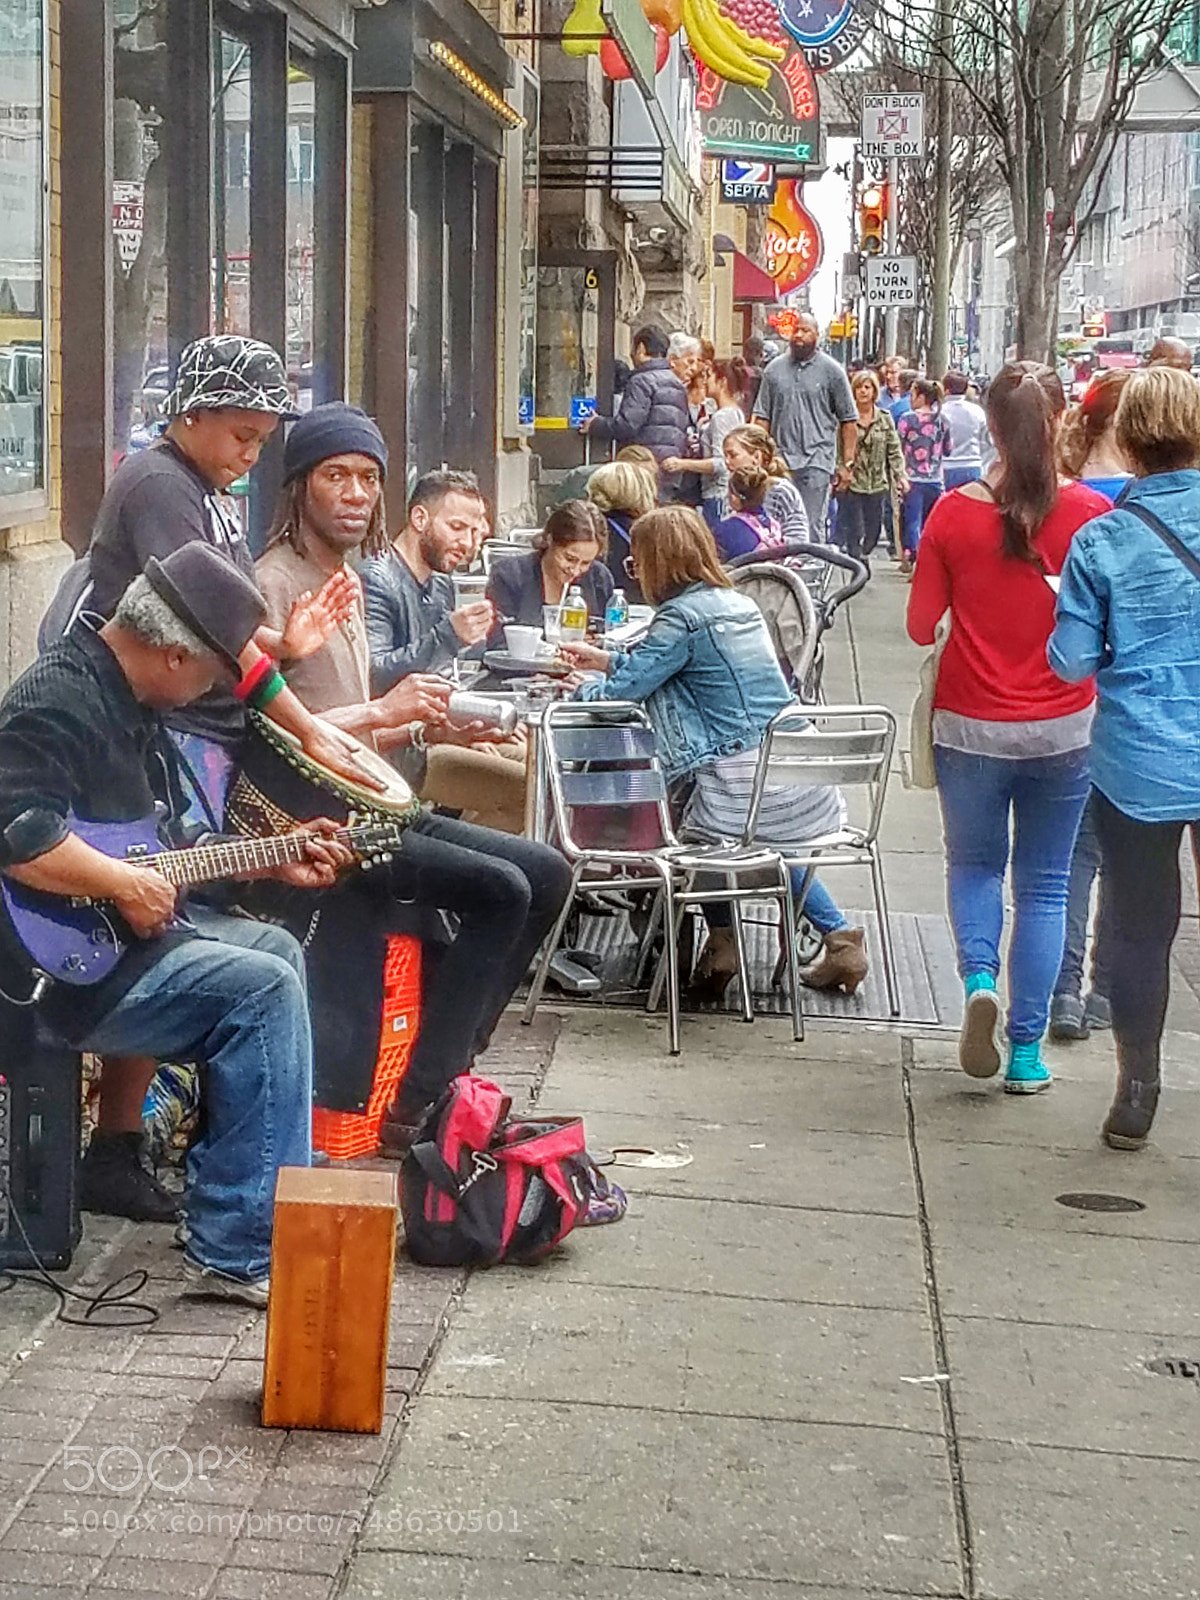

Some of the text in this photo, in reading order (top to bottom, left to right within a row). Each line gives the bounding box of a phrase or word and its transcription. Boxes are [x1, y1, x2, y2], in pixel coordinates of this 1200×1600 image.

[784, 53, 815, 120] DINER
[892, 97, 920, 108] BLOCK
[707, 117, 802, 143] OPEN TONIGHT
[866, 142, 918, 154] THE BOX
[724, 183, 769, 199] SEPTA
[883, 261, 899, 273] NO
[586, 268, 597, 288] 6
[874, 276, 908, 287] TURN
[870, 289, 913, 301] ON RED
